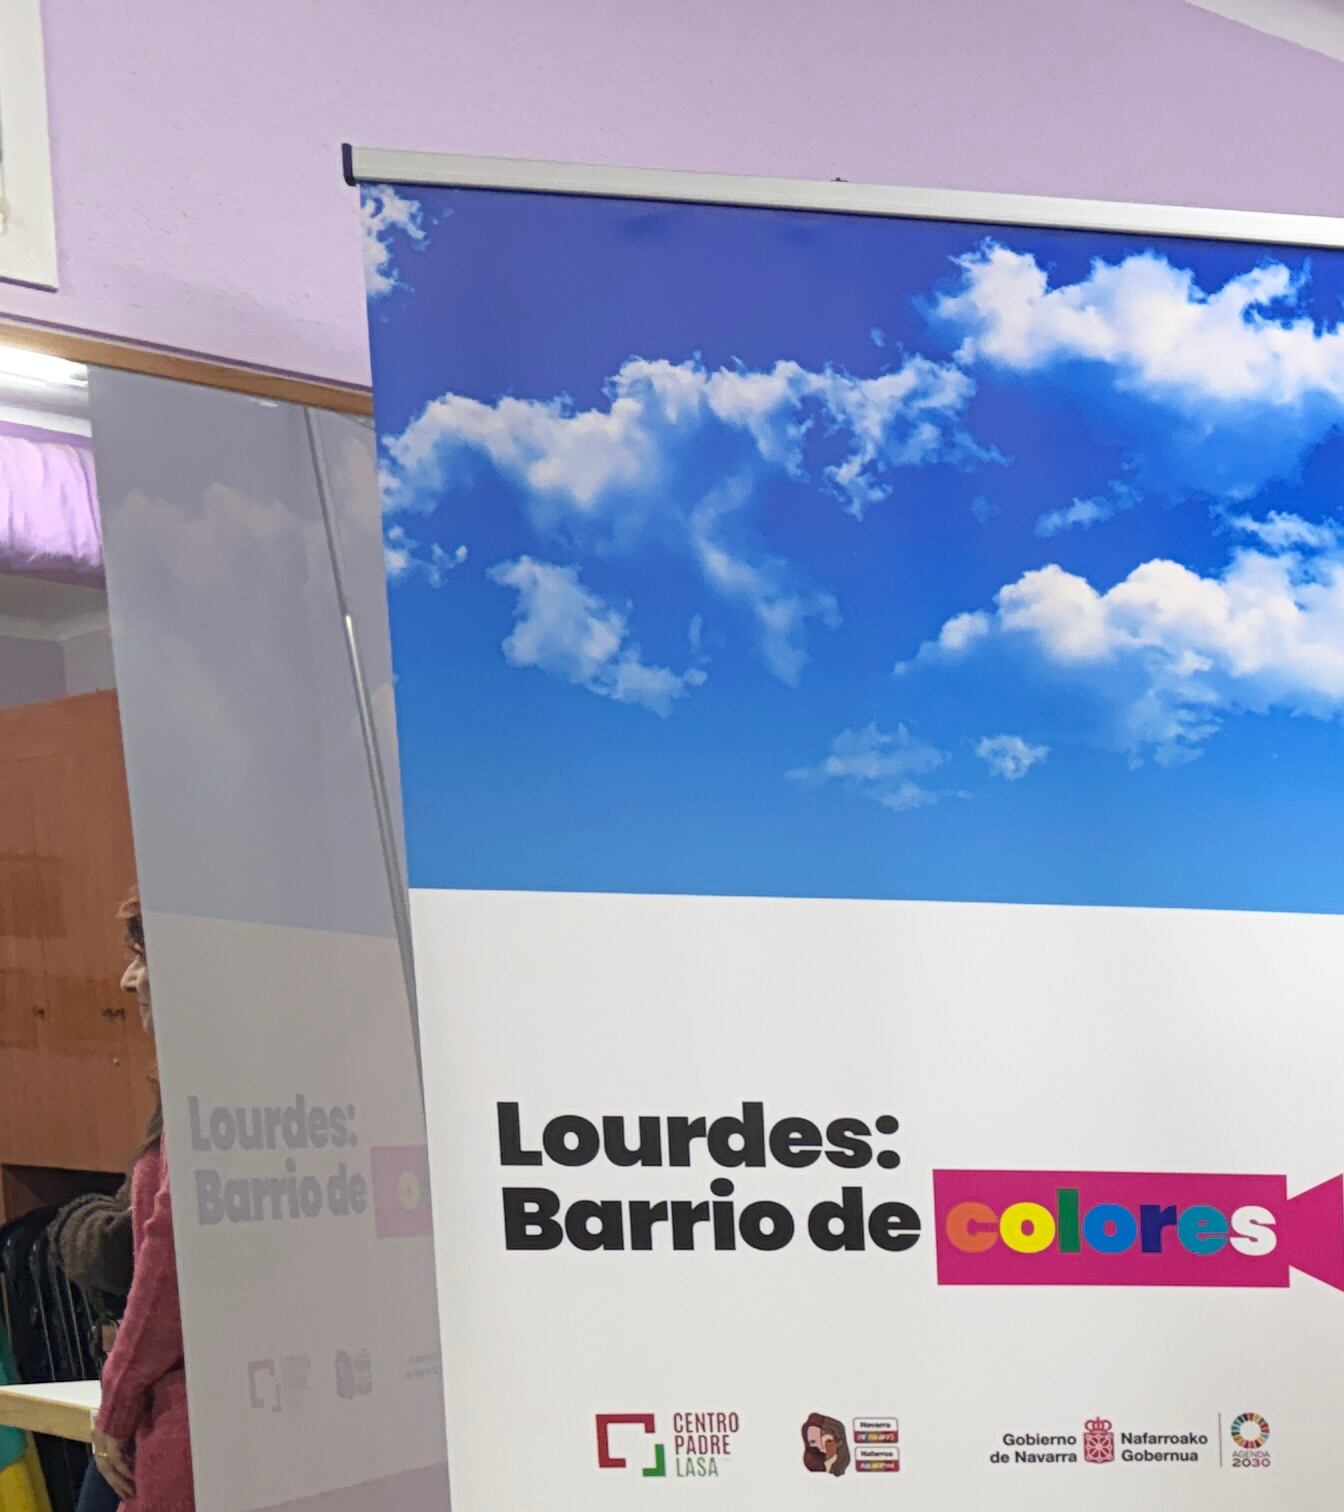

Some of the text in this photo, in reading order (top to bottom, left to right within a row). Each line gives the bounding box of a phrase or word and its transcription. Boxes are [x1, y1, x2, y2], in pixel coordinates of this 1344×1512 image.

[187, 1094, 358, 1152] Lourdes:
[497, 1102, 901, 1170] Lourdes:
[194, 1158, 321, 1226] Barrio
[327, 1164, 369, 1217] de
[502, 1178, 796, 1252] Barrio
[808, 1186, 922, 1252] de
[946, 1188, 1277, 1256] colores
[673, 1412, 739, 1433] CENTRO
[675, 1434, 731, 1455] PADRE
[1003, 1433, 1077, 1446] Gobierno
[1121, 1432, 1208, 1445] Nafarroako
[990, 1451, 1077, 1463] de Navarra
[1121, 1449, 1199, 1462] Gobernua
[1232, 1458, 1270, 1467] 2030
[676, 1457, 719, 1477] LASA
